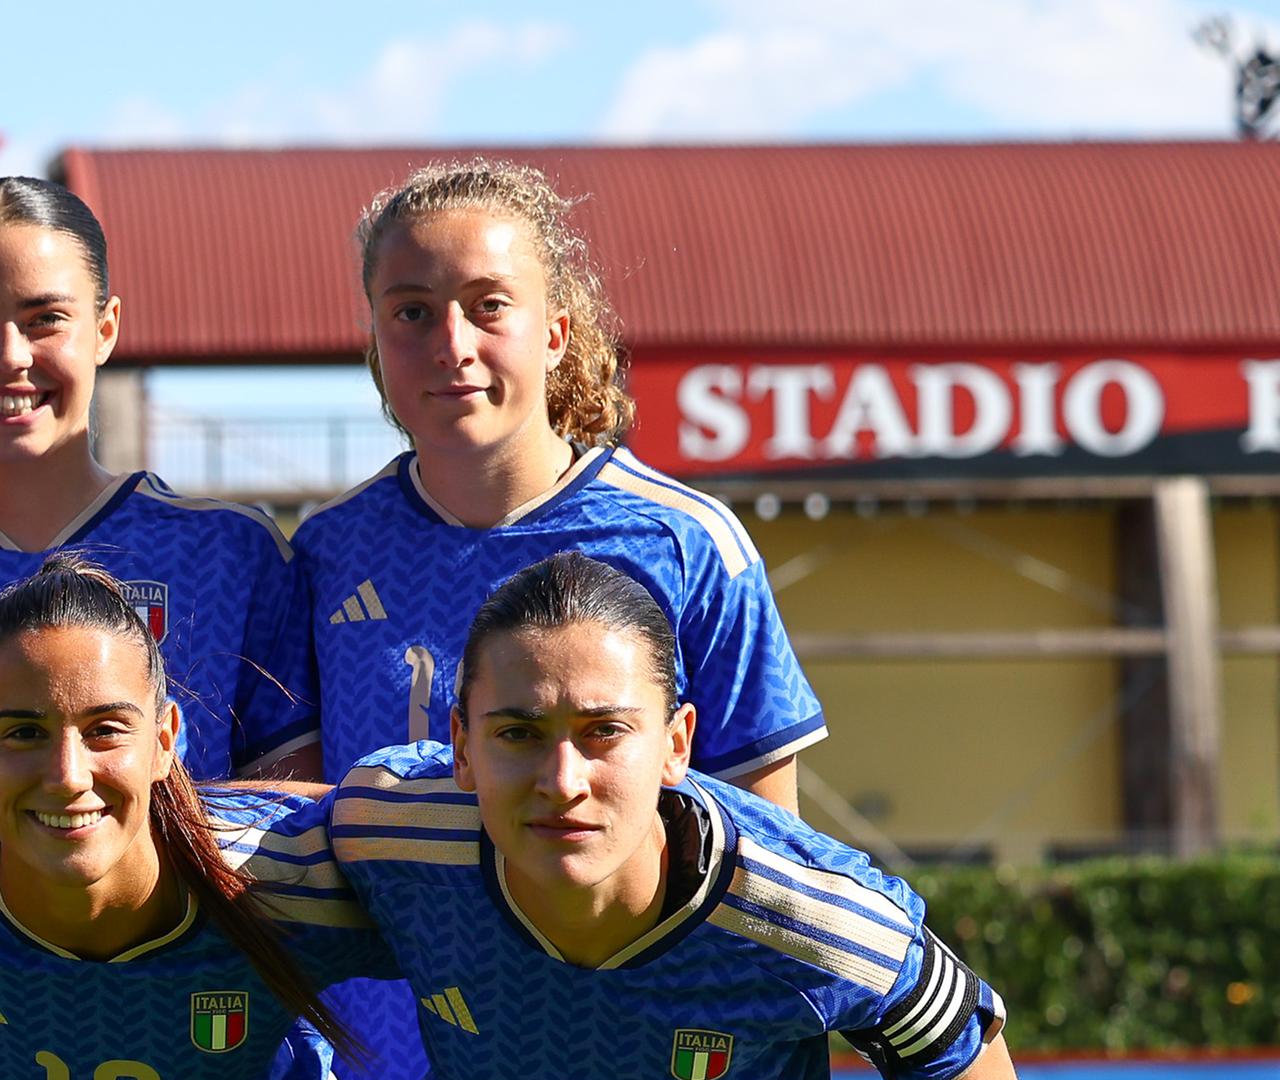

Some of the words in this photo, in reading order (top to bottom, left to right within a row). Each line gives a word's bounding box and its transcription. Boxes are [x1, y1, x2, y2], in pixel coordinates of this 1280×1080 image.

[676, 359, 1166, 461] STADIO
[196, 995, 243, 1010] ITALIA
[679, 1033, 728, 1049] ITALIA
